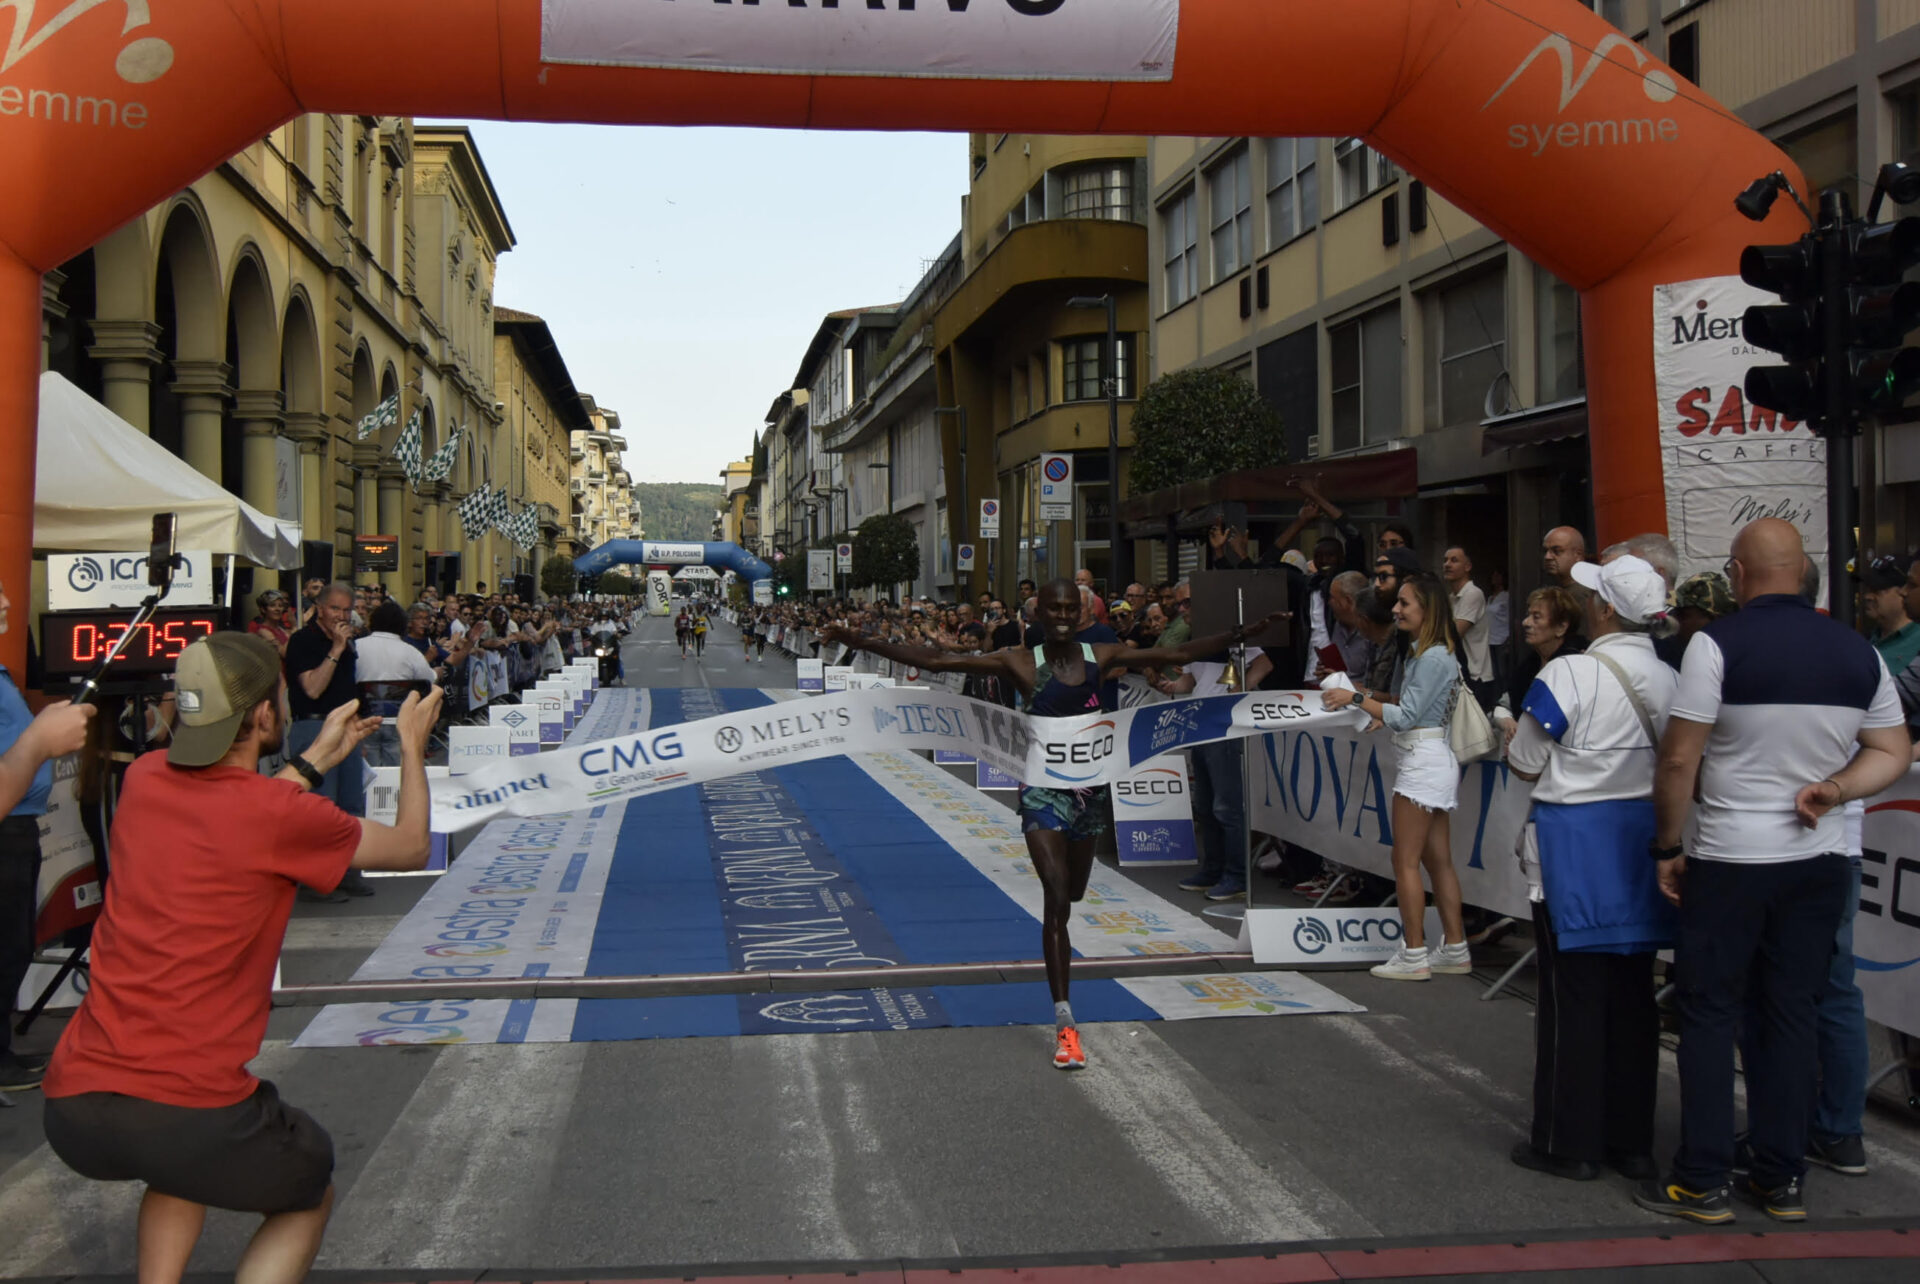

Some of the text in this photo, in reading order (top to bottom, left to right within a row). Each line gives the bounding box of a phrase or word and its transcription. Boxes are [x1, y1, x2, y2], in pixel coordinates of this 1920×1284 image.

[0, 85, 149, 129] emme
[1507, 117, 1679, 157] syemme
[1729, 494, 1812, 526] Mely's
[750, 706, 851, 744] MELY'S
[896, 704, 966, 738] TEST
[1251, 703, 1312, 721] SECO
[463, 744, 507, 757] TEST
[579, 731, 684, 777] CMG
[1045, 734, 1114, 764] SECO
[1116, 780, 1183, 796] SECO
[1261, 730, 1509, 871] NOVAT
[433, 897, 529, 942] estra
